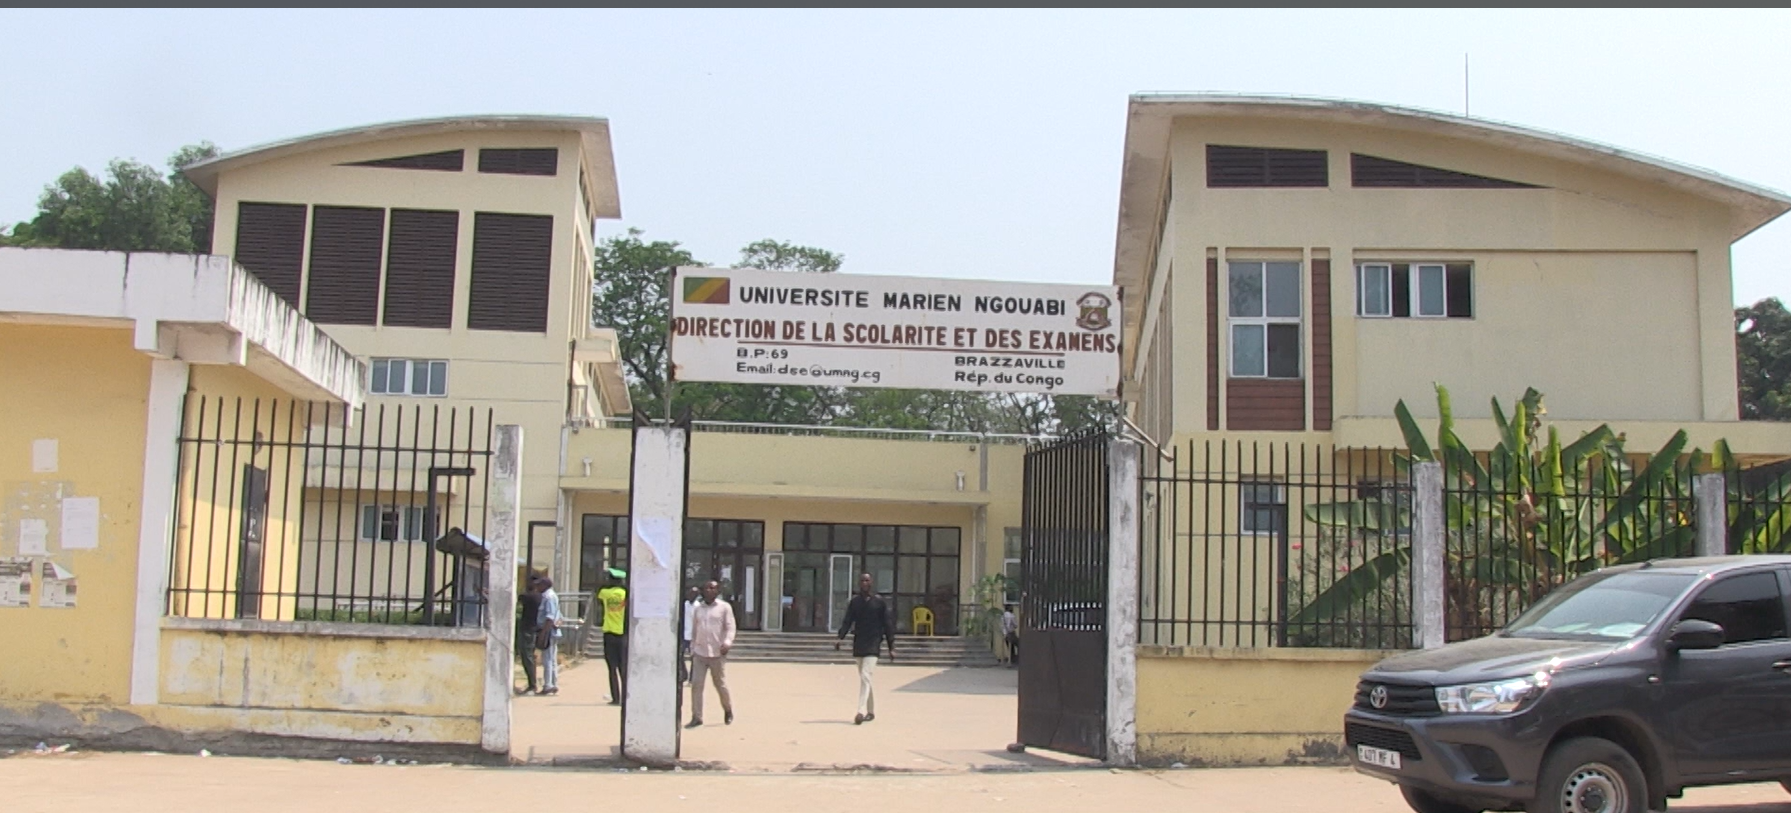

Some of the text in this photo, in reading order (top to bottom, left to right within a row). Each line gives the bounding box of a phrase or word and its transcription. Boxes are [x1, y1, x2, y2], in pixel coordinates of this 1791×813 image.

[739, 286, 1065, 316] UNIVERSITE MARIEN NGOUABI
[677, 317, 1116, 353] DIRECTION DE LA SCOLARITE ET DES EXAMENS
[955, 356, 1065, 369] BRAZZAVILLE
[955, 370, 1064, 389] Rép. du Congo
